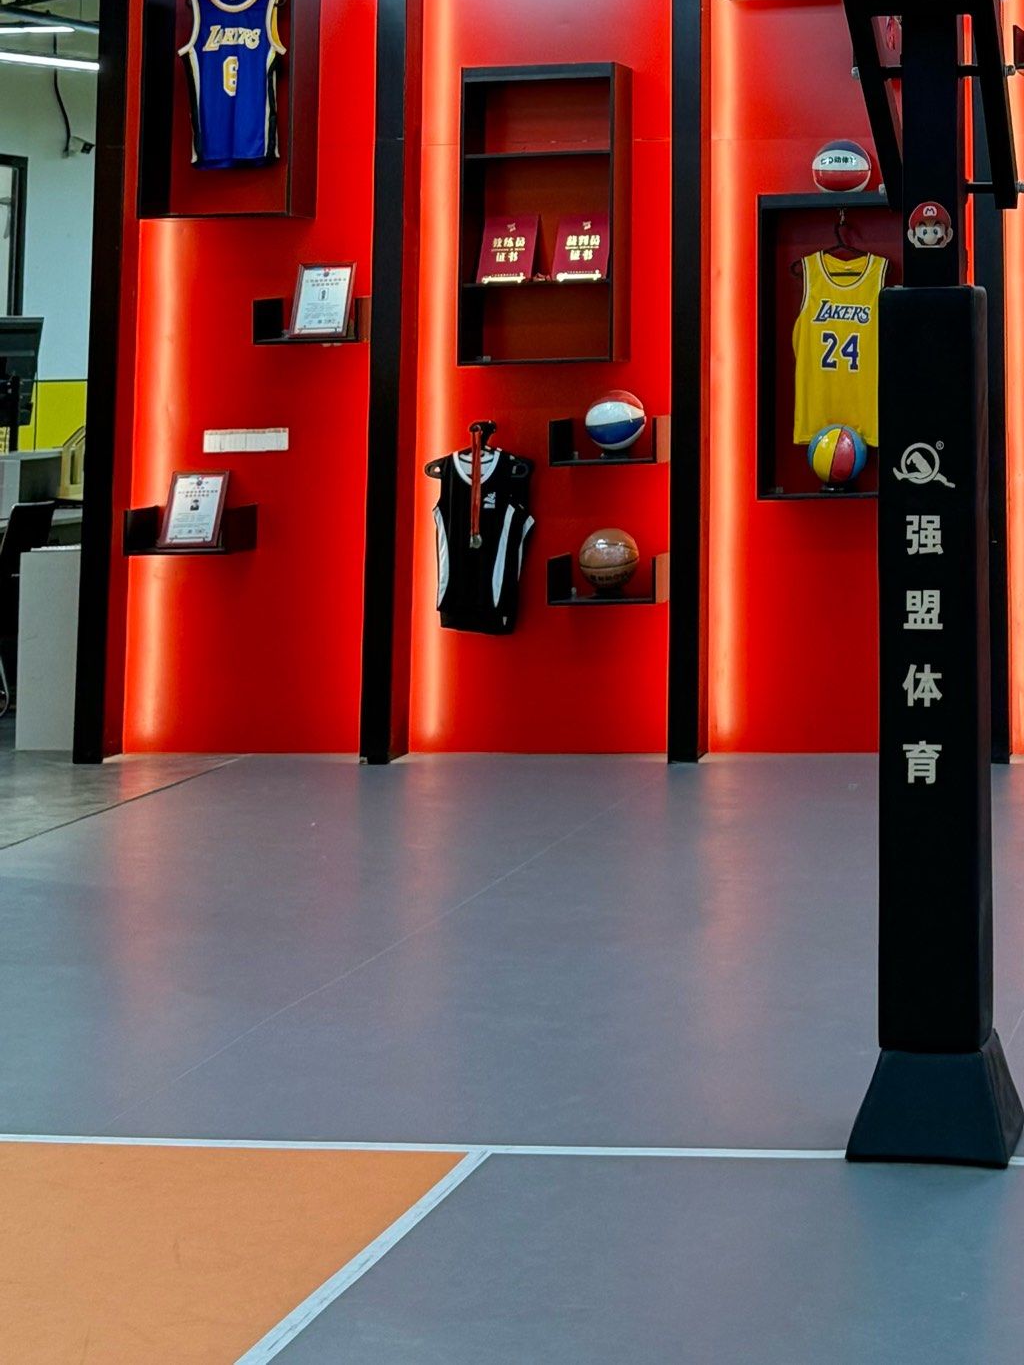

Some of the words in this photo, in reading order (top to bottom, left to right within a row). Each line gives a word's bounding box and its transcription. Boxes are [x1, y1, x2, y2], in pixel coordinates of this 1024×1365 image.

[812, 299, 871, 325] LAKERS
[820, 331, 860, 372] 24
[903, 514, 944, 785] 强盟体育
